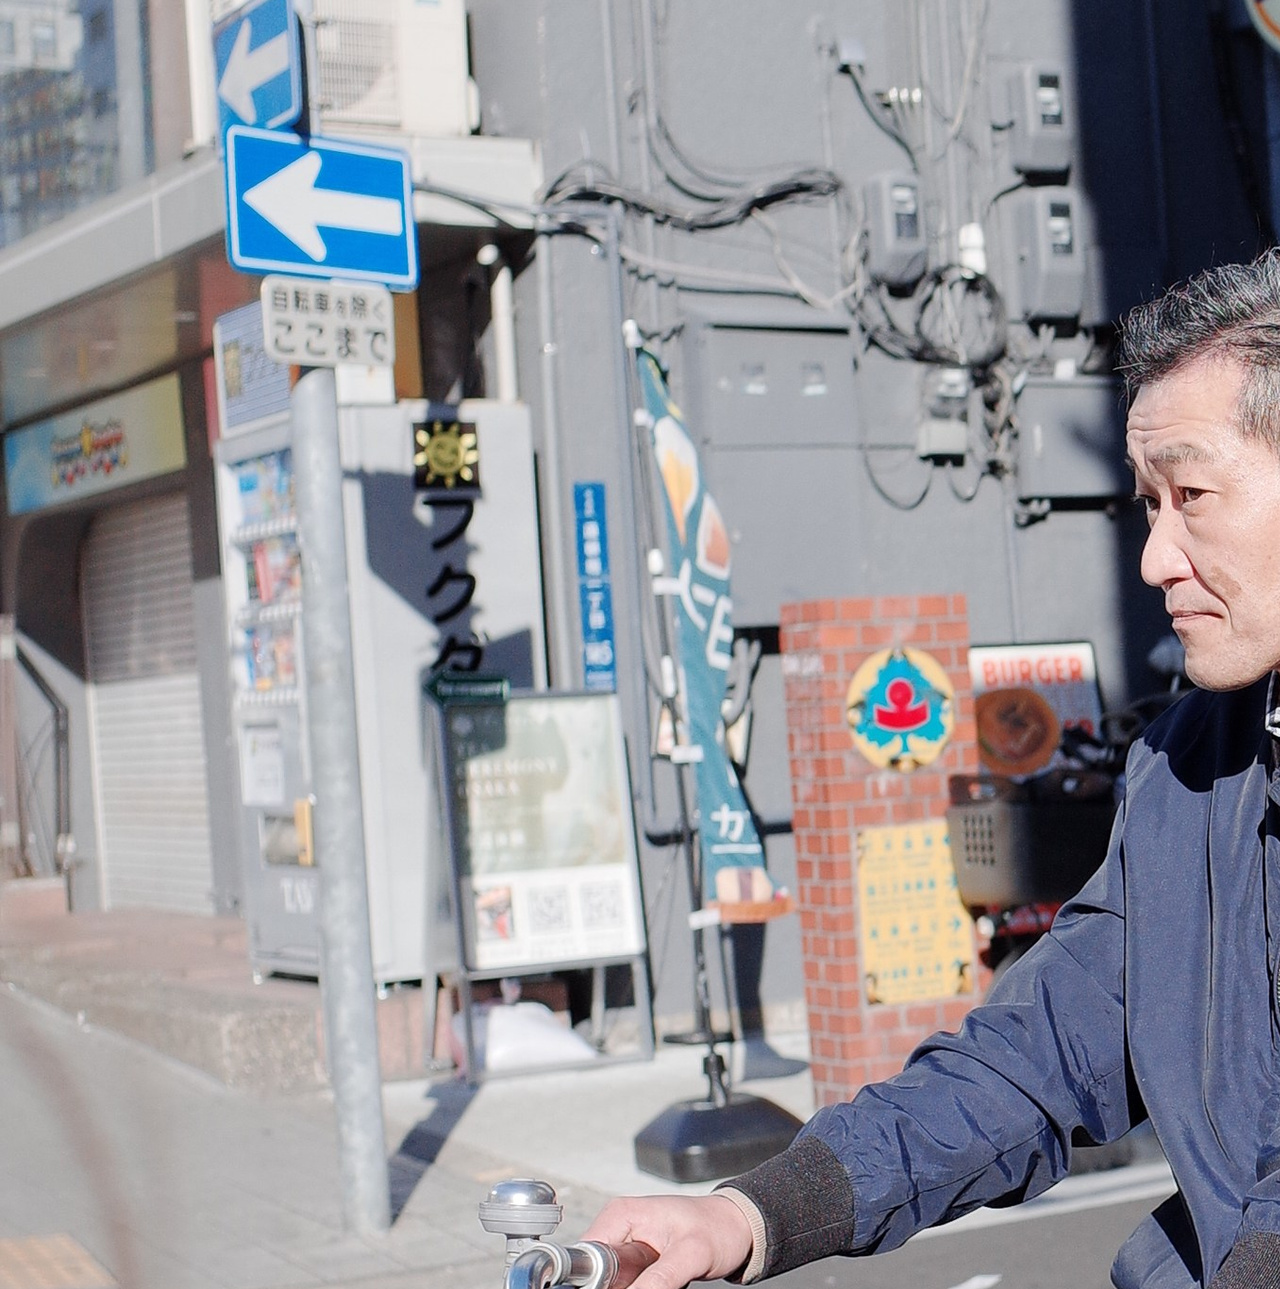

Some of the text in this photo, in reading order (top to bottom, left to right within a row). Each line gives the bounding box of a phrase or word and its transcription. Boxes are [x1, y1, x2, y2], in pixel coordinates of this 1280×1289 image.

[273, 320, 389, 363] ここまで
[982, 657, 1085, 687] BURGER
